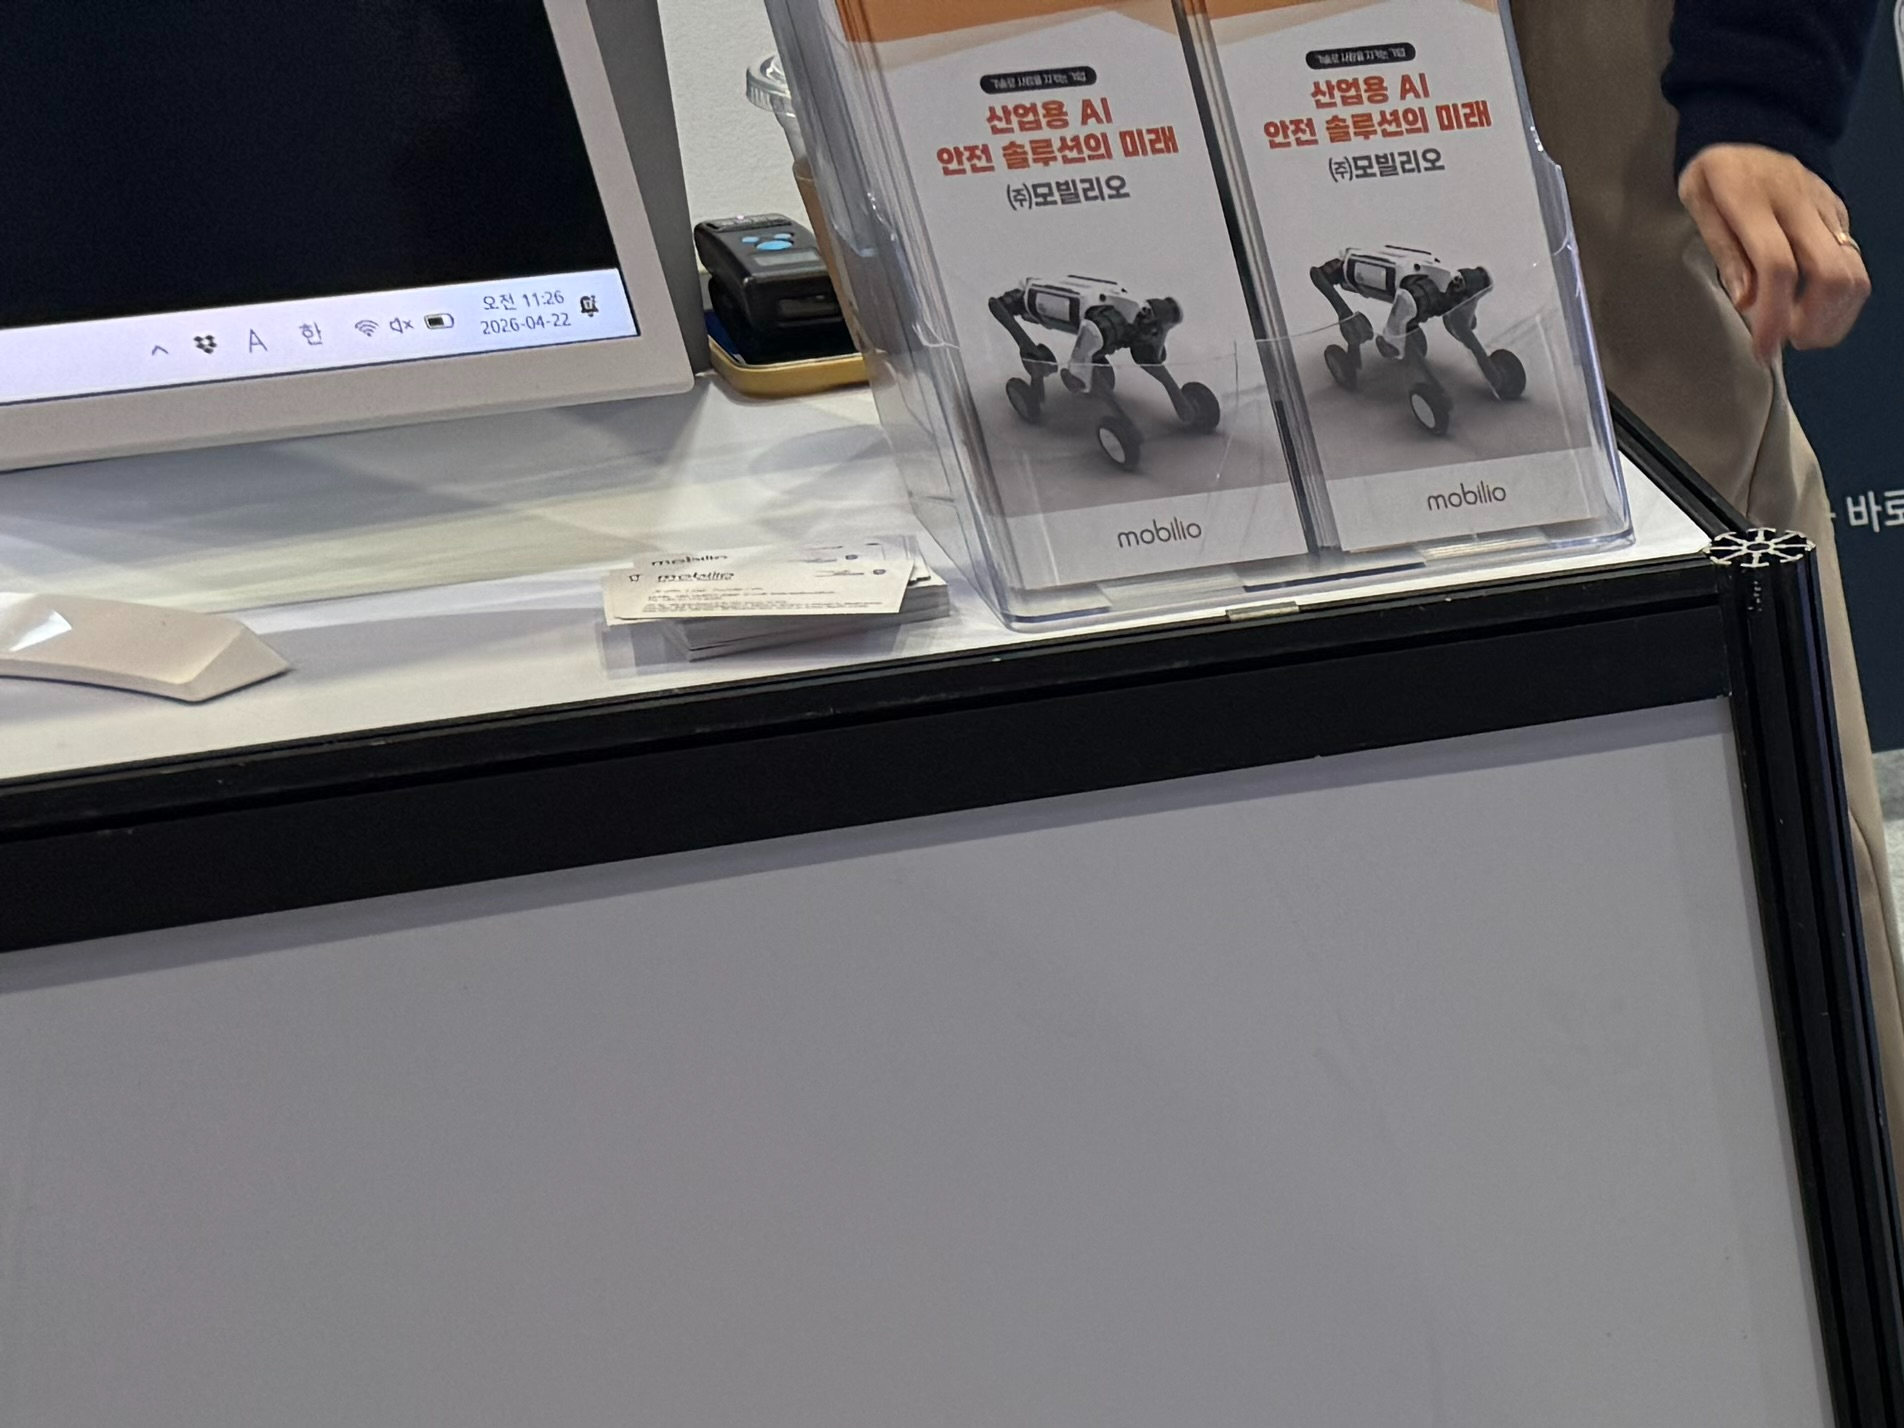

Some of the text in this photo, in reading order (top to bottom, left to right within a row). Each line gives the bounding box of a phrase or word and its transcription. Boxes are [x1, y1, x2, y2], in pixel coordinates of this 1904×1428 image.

[1311, 72, 1430, 109] 산업용 AI
[986, 97, 1113, 135] 산업용 AI
[1263, 100, 1492, 149] 안전 솔루션의 미래
[936, 125, 1179, 176] 안전 솔루션의 미래
[482, 290, 565, 312] 오전 11:26
[299, 322, 322, 346] 한
[480, 313, 571, 336] 2026-04-22
[248, 329, 268, 354] A
[1427, 480, 1507, 512] mobilio
[1117, 516, 1202, 549] mobilio
